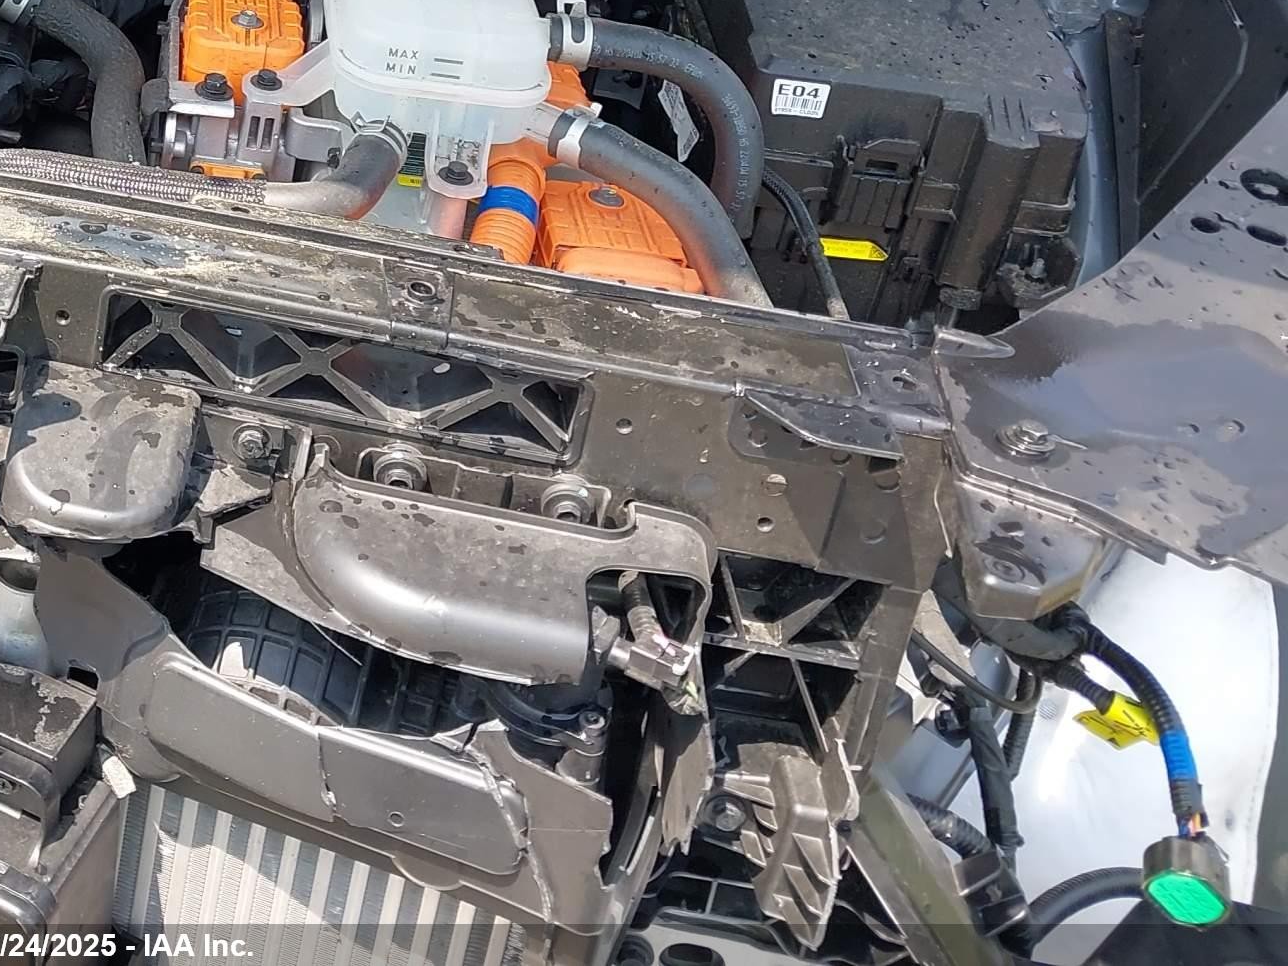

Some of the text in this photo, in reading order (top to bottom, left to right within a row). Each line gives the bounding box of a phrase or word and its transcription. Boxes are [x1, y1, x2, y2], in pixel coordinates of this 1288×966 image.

[388, 47, 419, 60] MAX
[385, 61, 417, 75] MIN
[777, 83, 821, 99] E04
